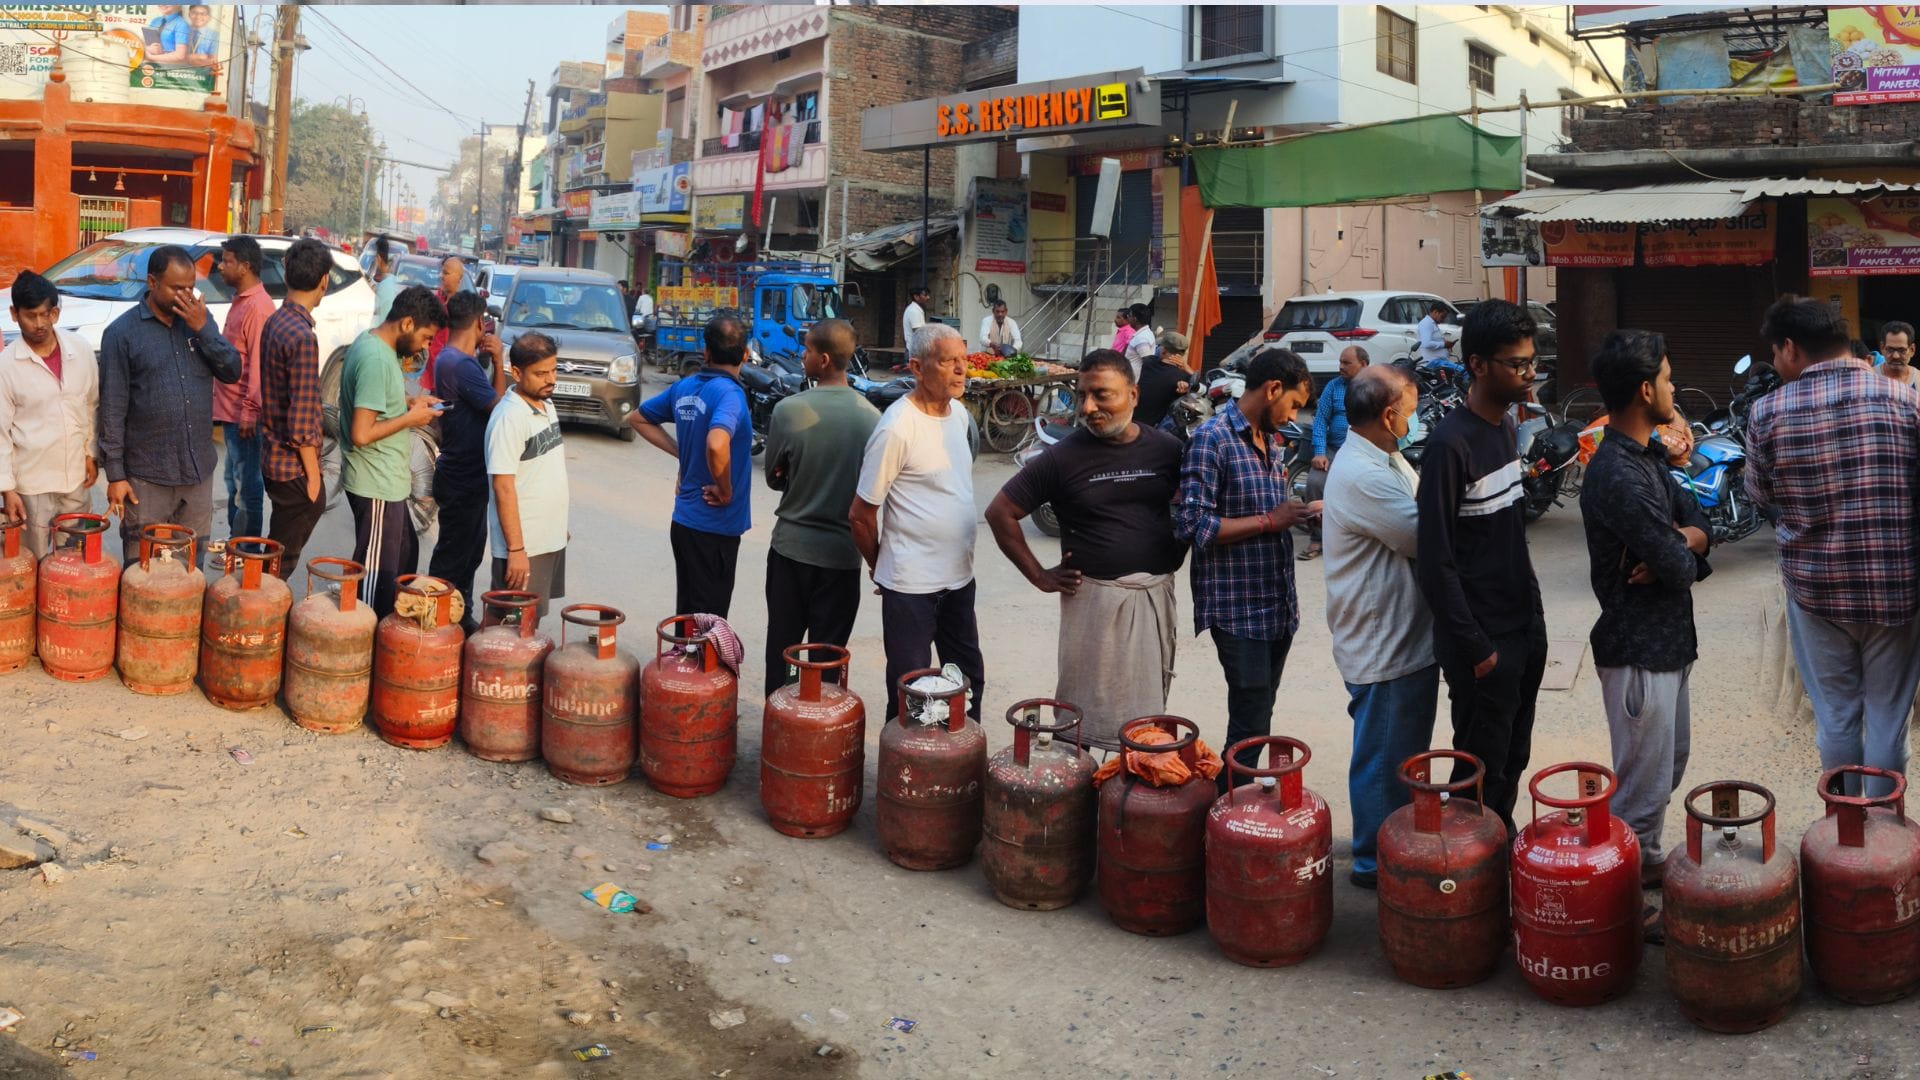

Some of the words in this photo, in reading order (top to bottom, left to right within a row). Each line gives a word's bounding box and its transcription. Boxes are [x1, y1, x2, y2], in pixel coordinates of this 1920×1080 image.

[101, 4, 147, 15] OPEN
[1873, 68, 1910, 77] MITHAI
[937, 104, 977, 137] S.S.
[979, 86, 1093, 132] RESIDENCY
[1556, 836, 1580, 846] 15.5
[1514, 929, 1611, 981] Indane
